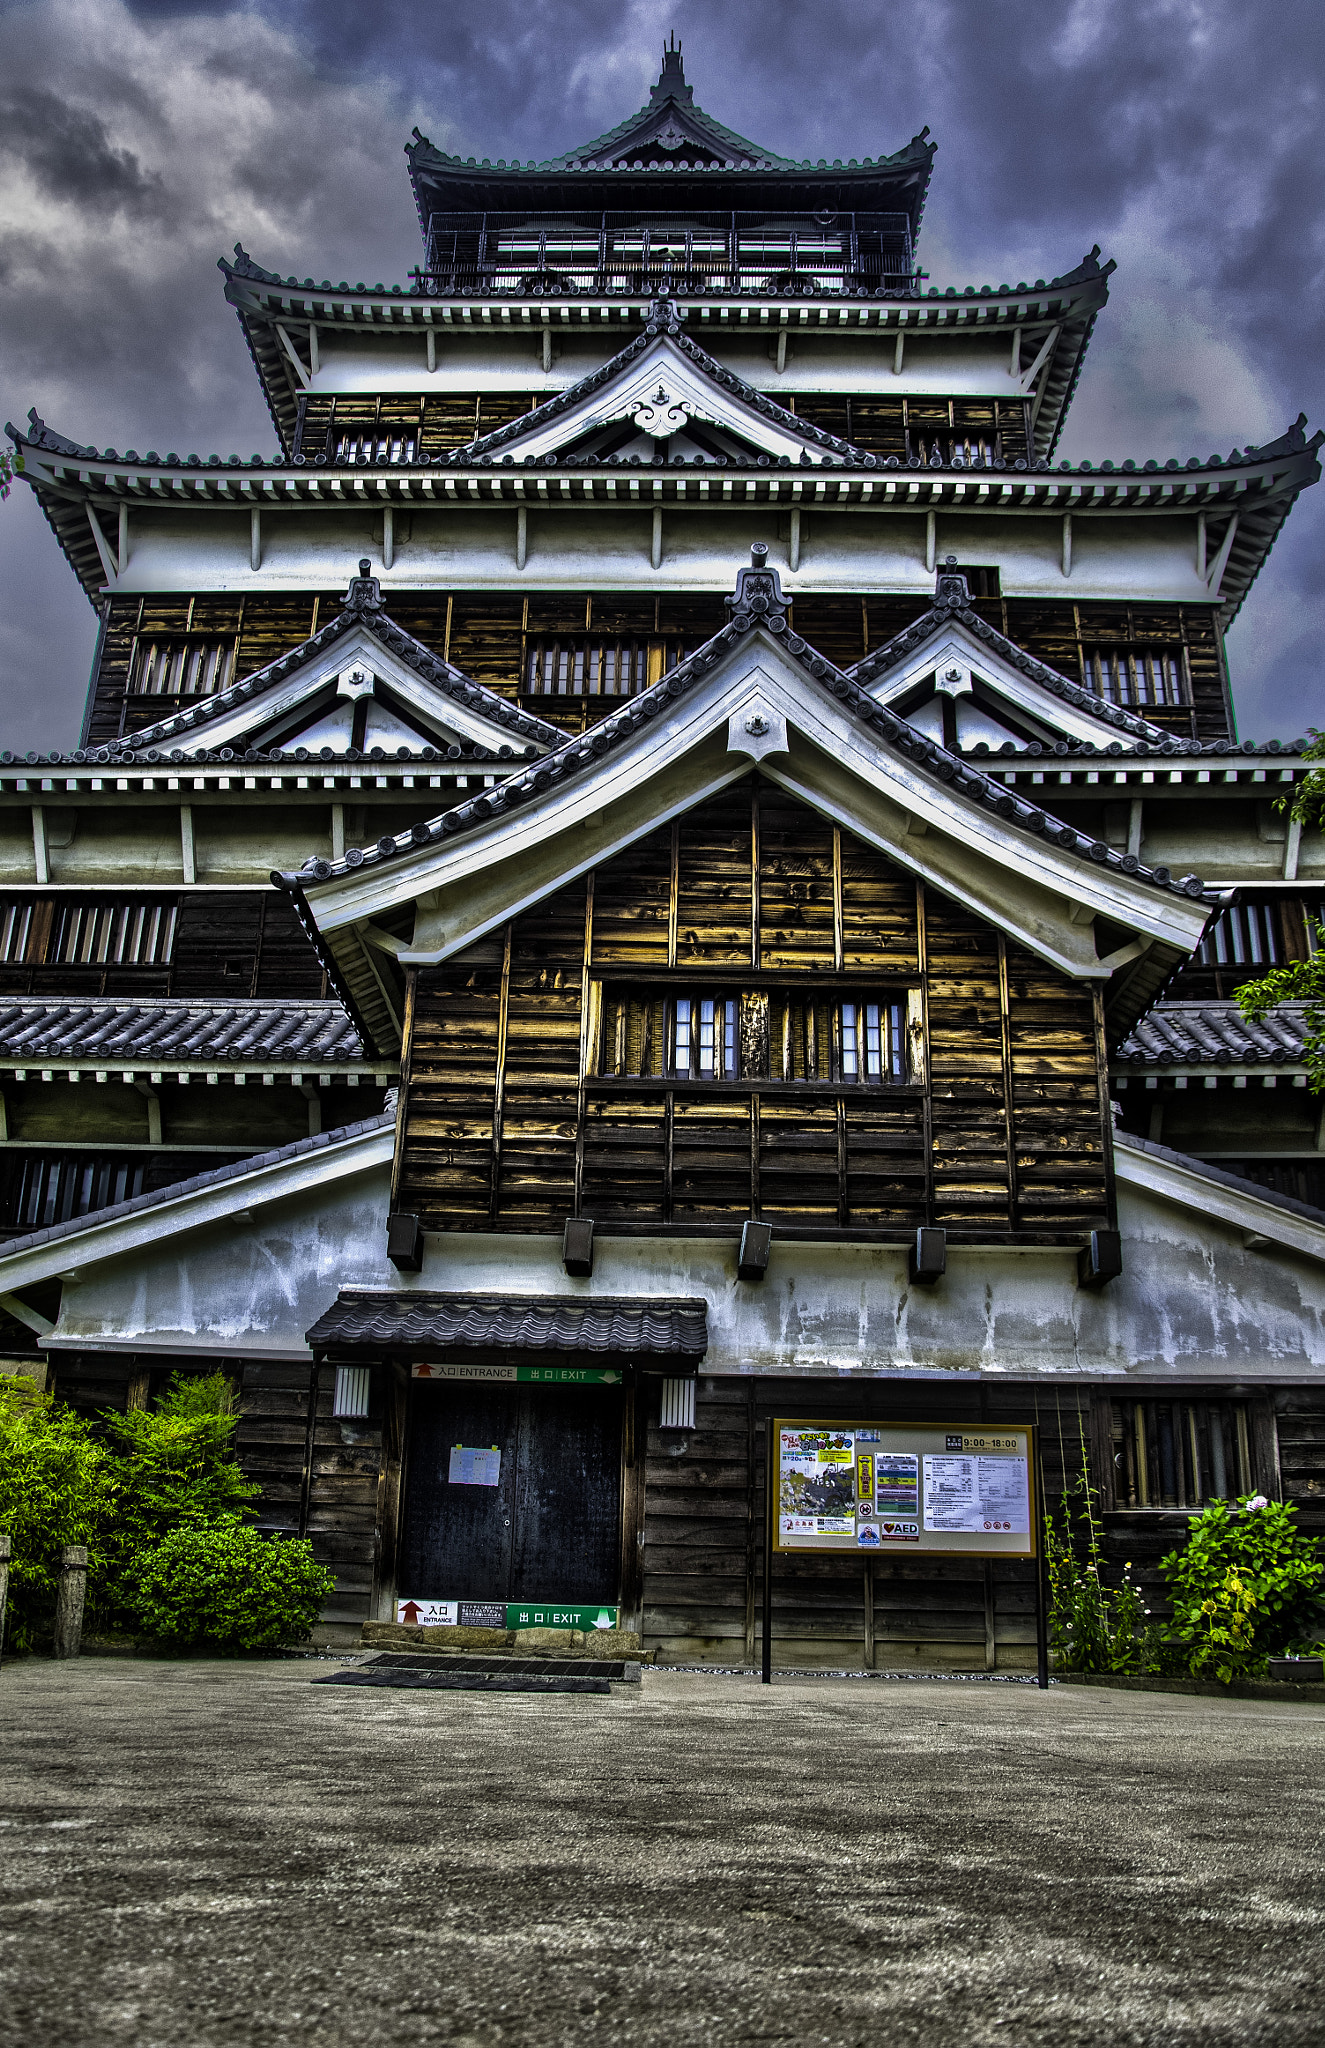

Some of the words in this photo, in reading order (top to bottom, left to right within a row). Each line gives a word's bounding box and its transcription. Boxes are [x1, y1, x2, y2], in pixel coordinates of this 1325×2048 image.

[438, 1367, 456, 1376] 入口
[459, 1367, 514, 1378] ENTRANCE
[530, 1370, 553, 1379] 出口
[561, 1370, 587, 1380] EXIT
[894, 1524, 918, 1533] AED
[429, 1606, 448, 1616] 入口
[423, 1616, 453, 1624] ENTRANCE
[519, 1612, 545, 1623] 出口
[553, 1614, 582, 1624] EXIT
